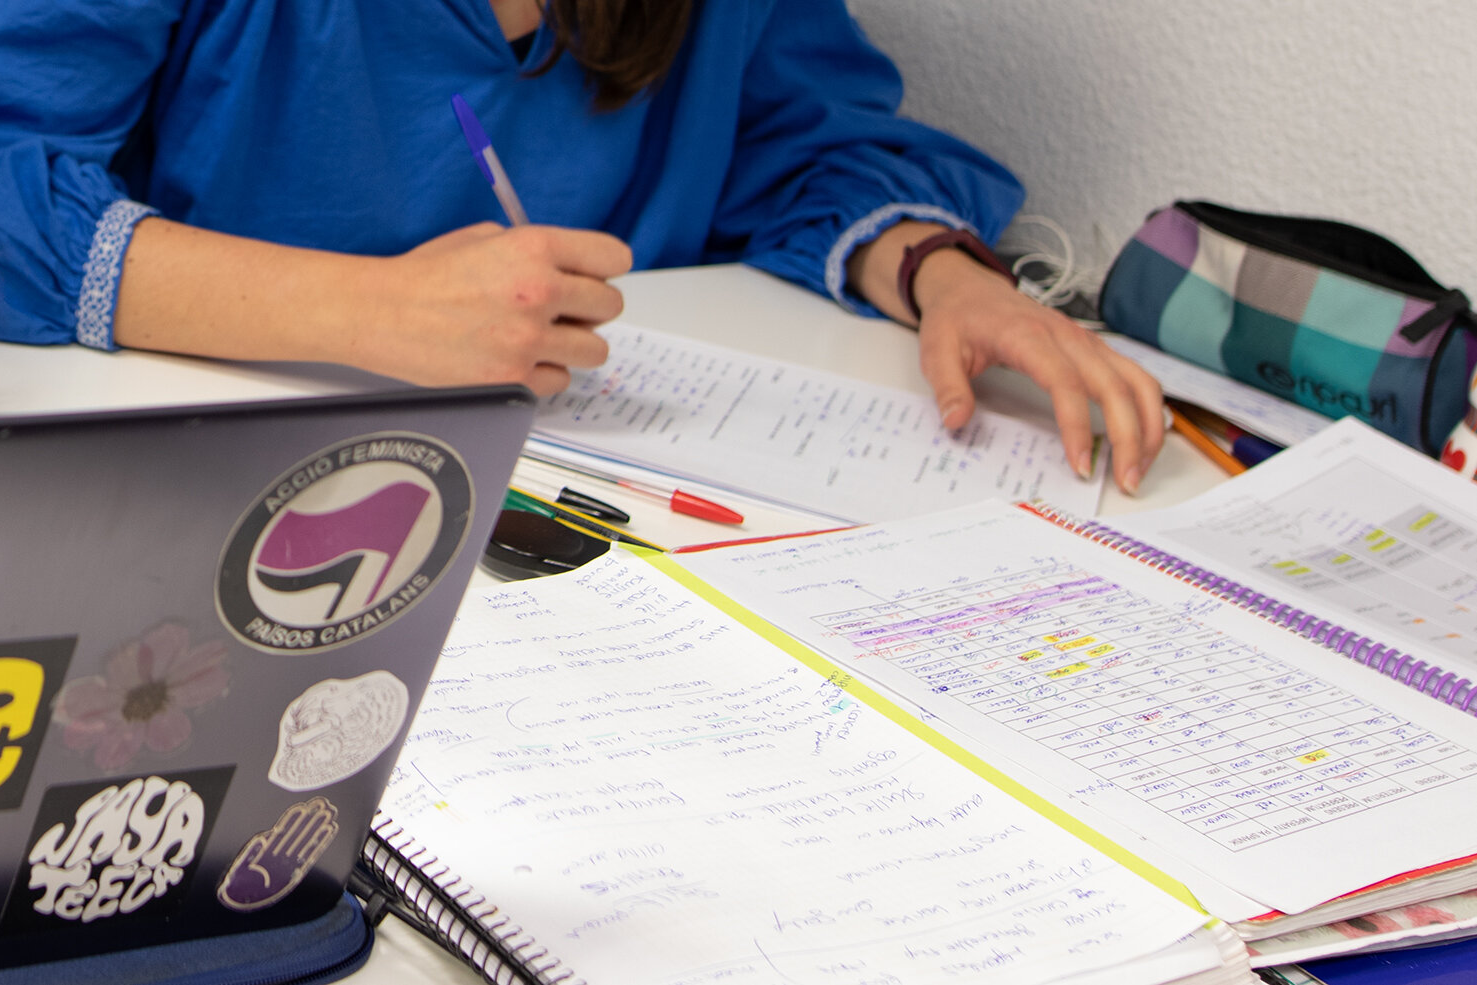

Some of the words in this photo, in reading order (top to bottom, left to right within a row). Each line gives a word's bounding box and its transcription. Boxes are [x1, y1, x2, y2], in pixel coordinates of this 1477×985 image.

[263, 454, 334, 515] ACCIÓ
[338, 440, 446, 475] FEMINISTA
[244, 616, 316, 649] PAÏSOS
[319, 572, 431, 644] CATALANS
